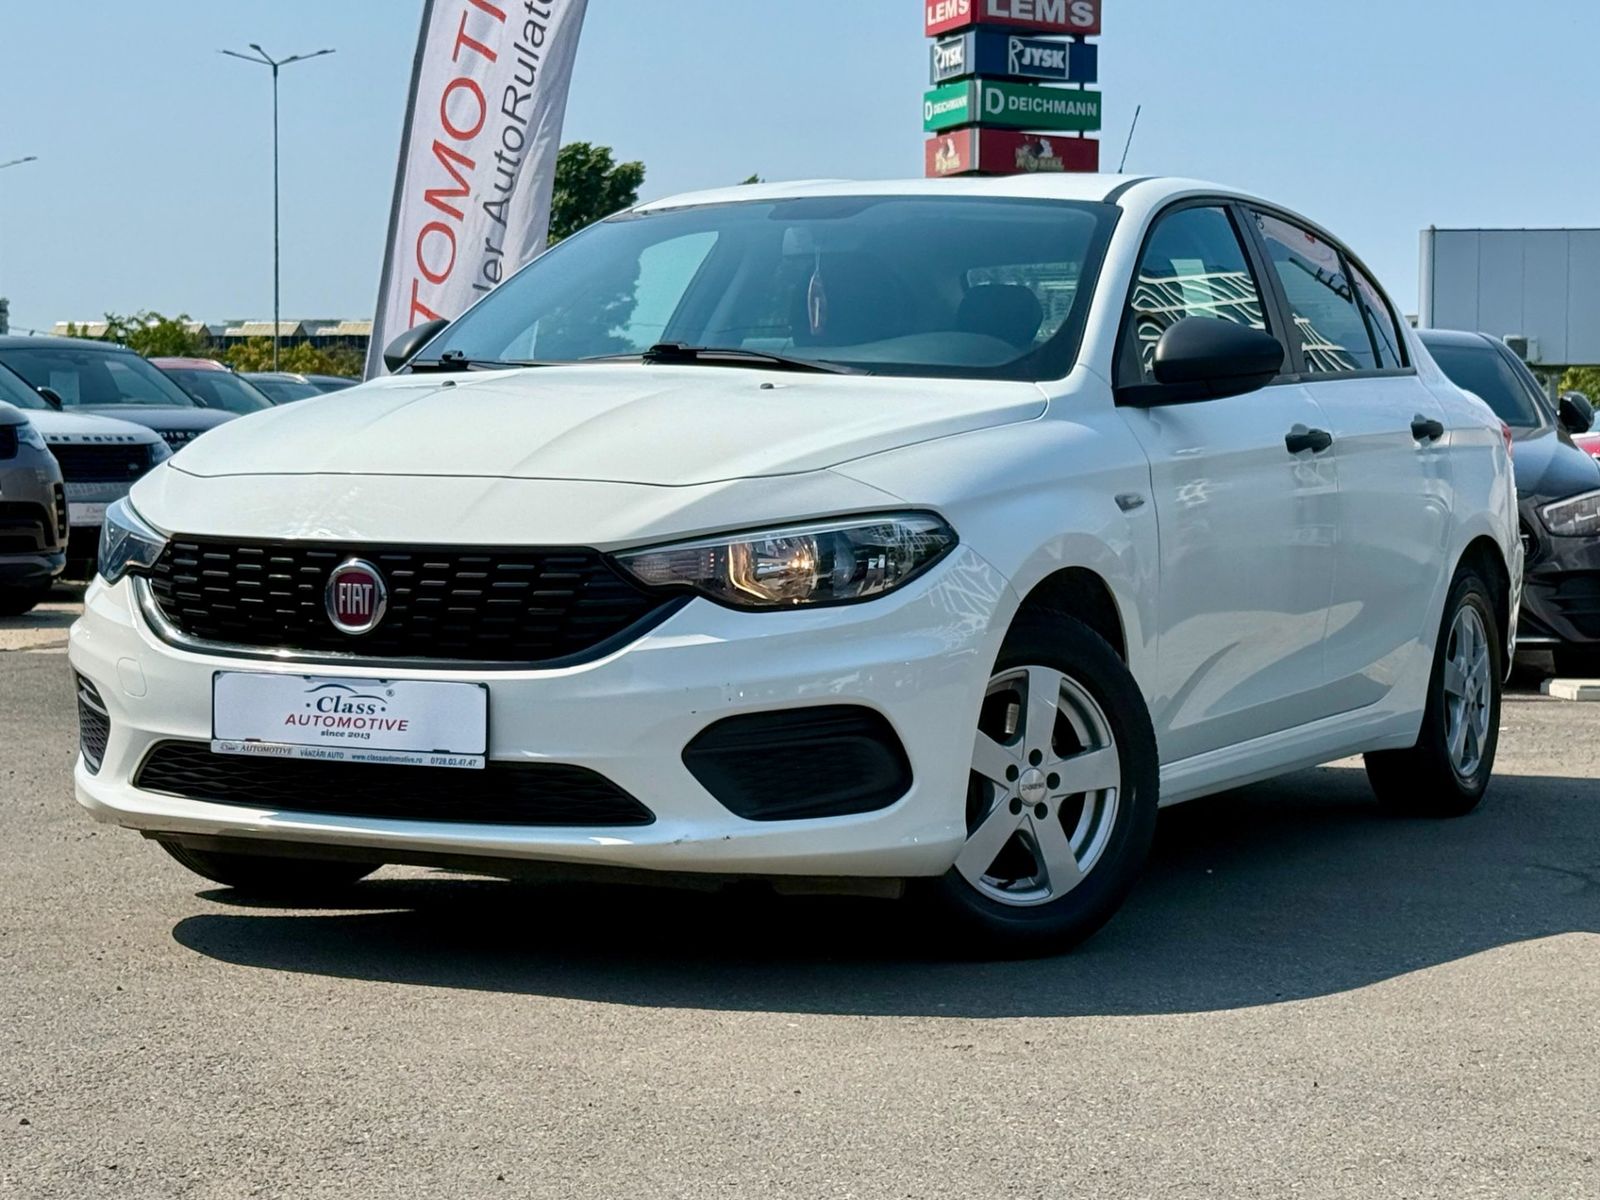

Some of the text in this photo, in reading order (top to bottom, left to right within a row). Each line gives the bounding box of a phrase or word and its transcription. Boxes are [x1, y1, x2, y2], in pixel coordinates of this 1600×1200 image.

[940, 45, 963, 69] JYSK
[1021, 47, 1065, 69] JYSK
[985, 88, 1097, 117] D DEICHMANN
[339, 583, 373, 615] FIAT
[317, 695, 376, 715] Class
[285, 713, 410, 732] AUTOMOTIVE
[320, 729, 371, 740] since 2013
[327, 751, 345, 760] AUTO
